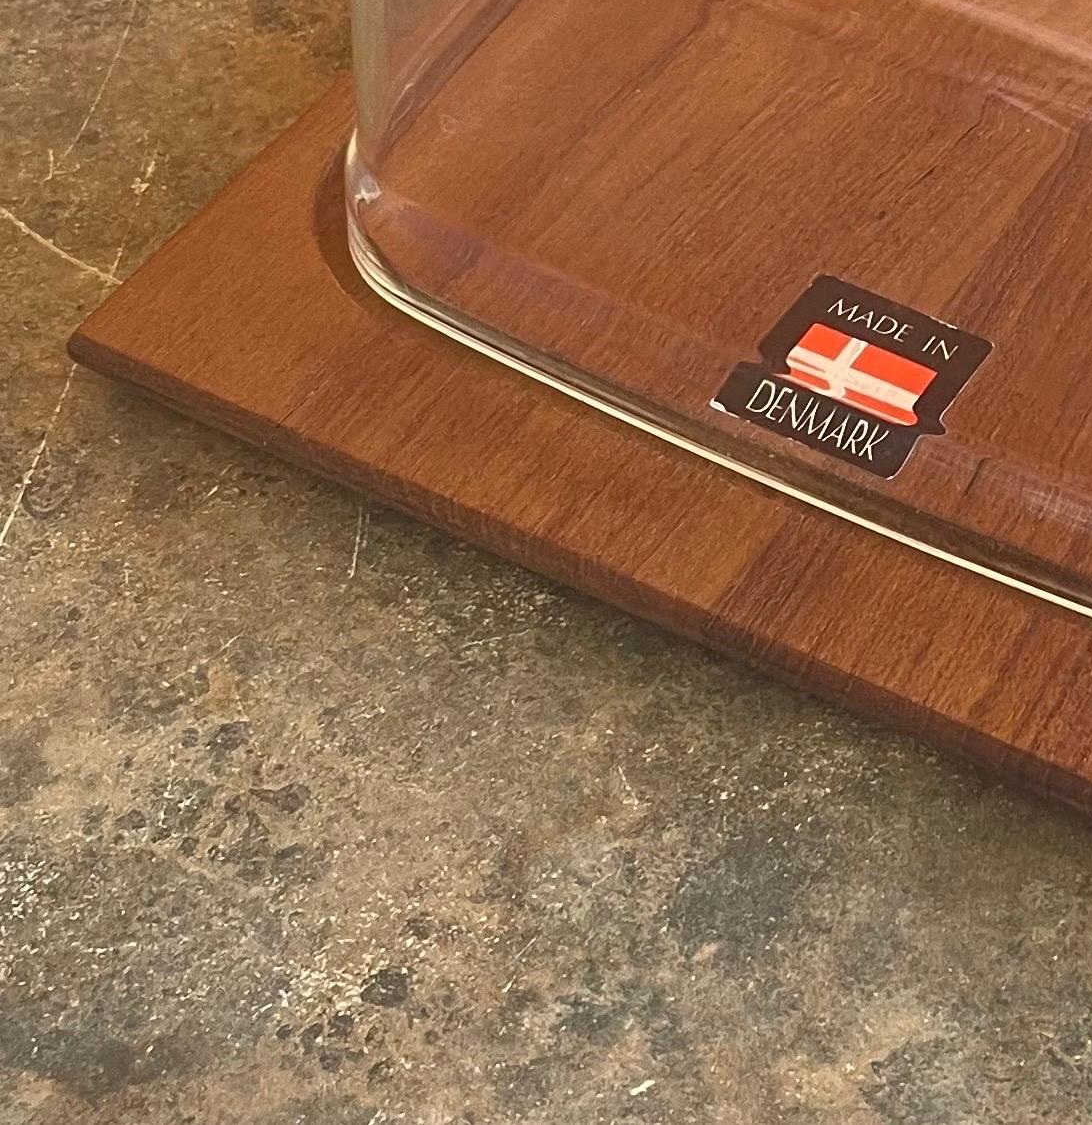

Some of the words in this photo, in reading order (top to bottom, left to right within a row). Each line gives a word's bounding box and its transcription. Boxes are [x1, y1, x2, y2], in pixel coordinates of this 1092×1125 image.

[827, 298, 914, 342] MADE
[921, 335, 959, 361] IN
[745, 379, 890, 461] DENMARK
